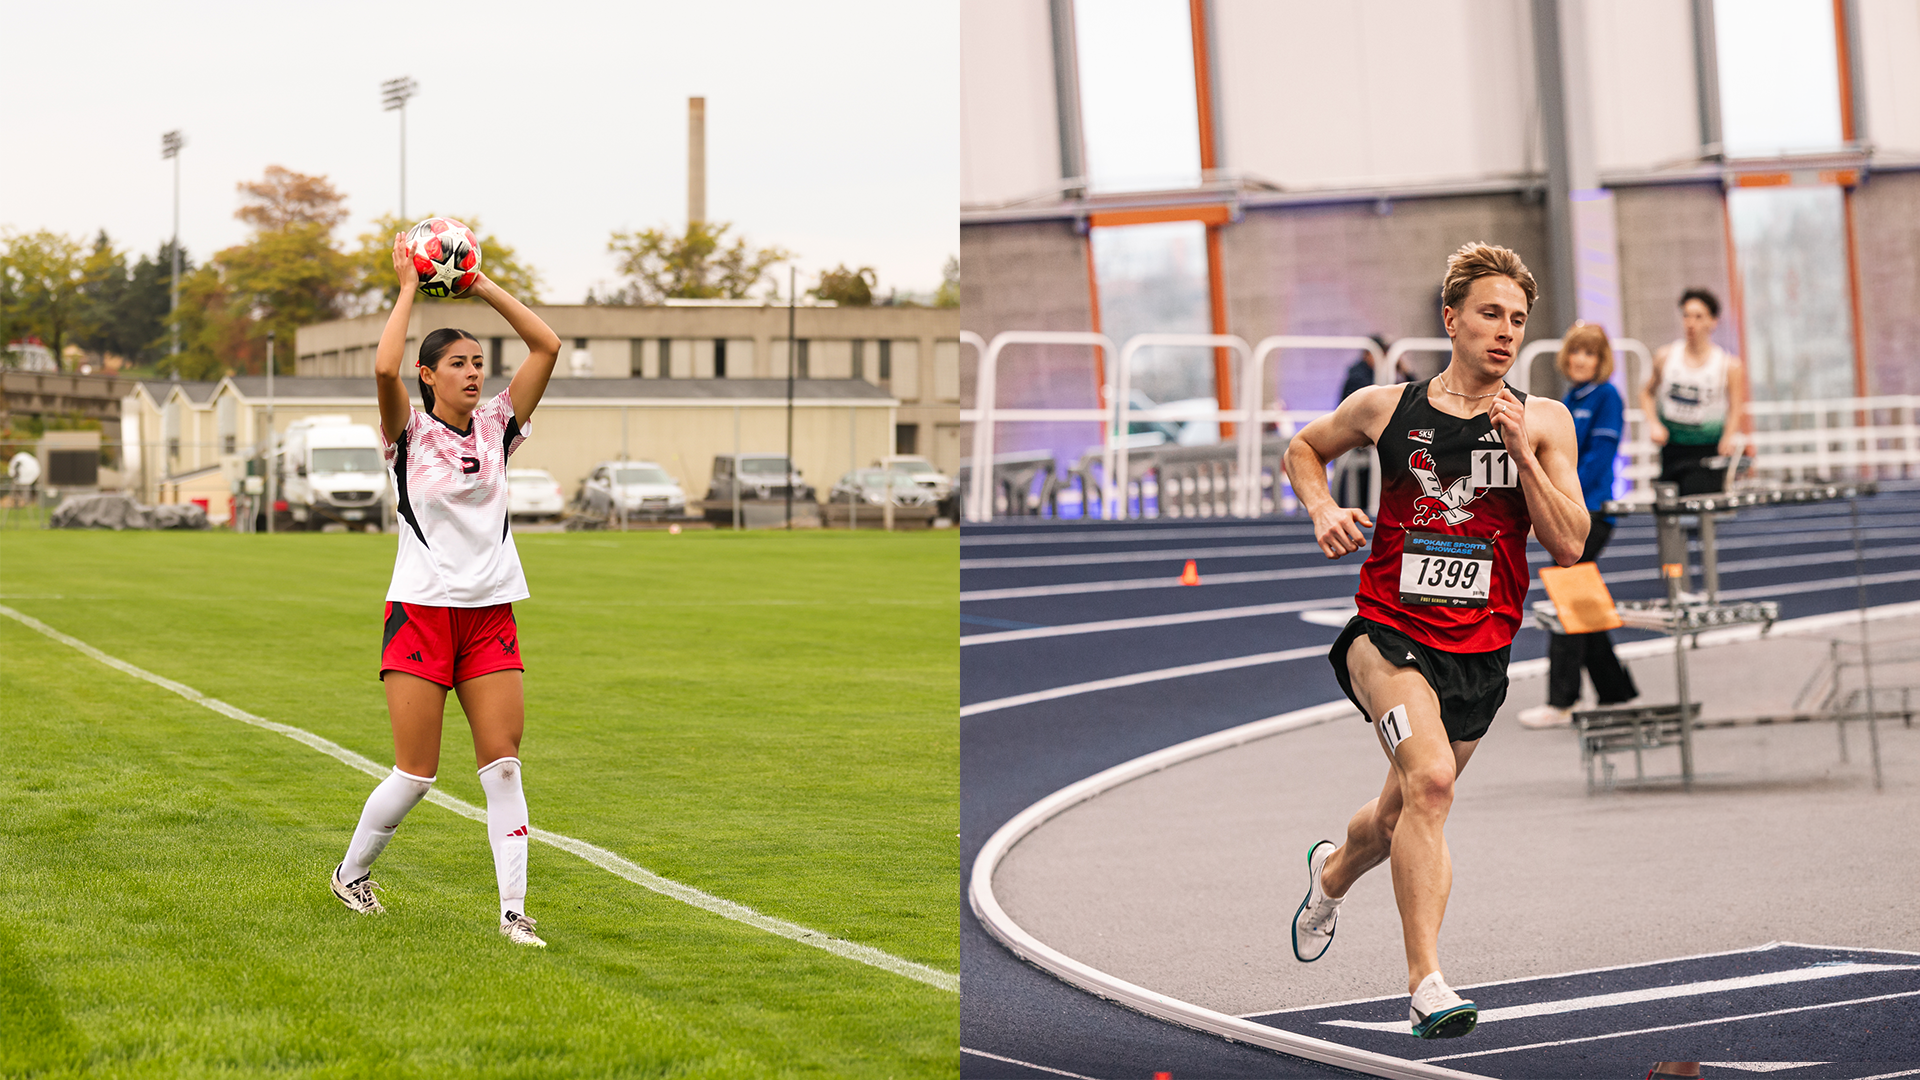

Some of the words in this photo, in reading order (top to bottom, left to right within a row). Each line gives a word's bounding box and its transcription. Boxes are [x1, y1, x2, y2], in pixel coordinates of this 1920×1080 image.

[1480, 452, 1509, 485] 11
[1412, 538, 1453, 548] SPOKANE
[1453, 542, 1487, 550] SPORTS
[1425, 545, 1474, 555] SHOWCASE
[1417, 557, 1480, 589] 1399
[1381, 711, 1402, 749] 11
